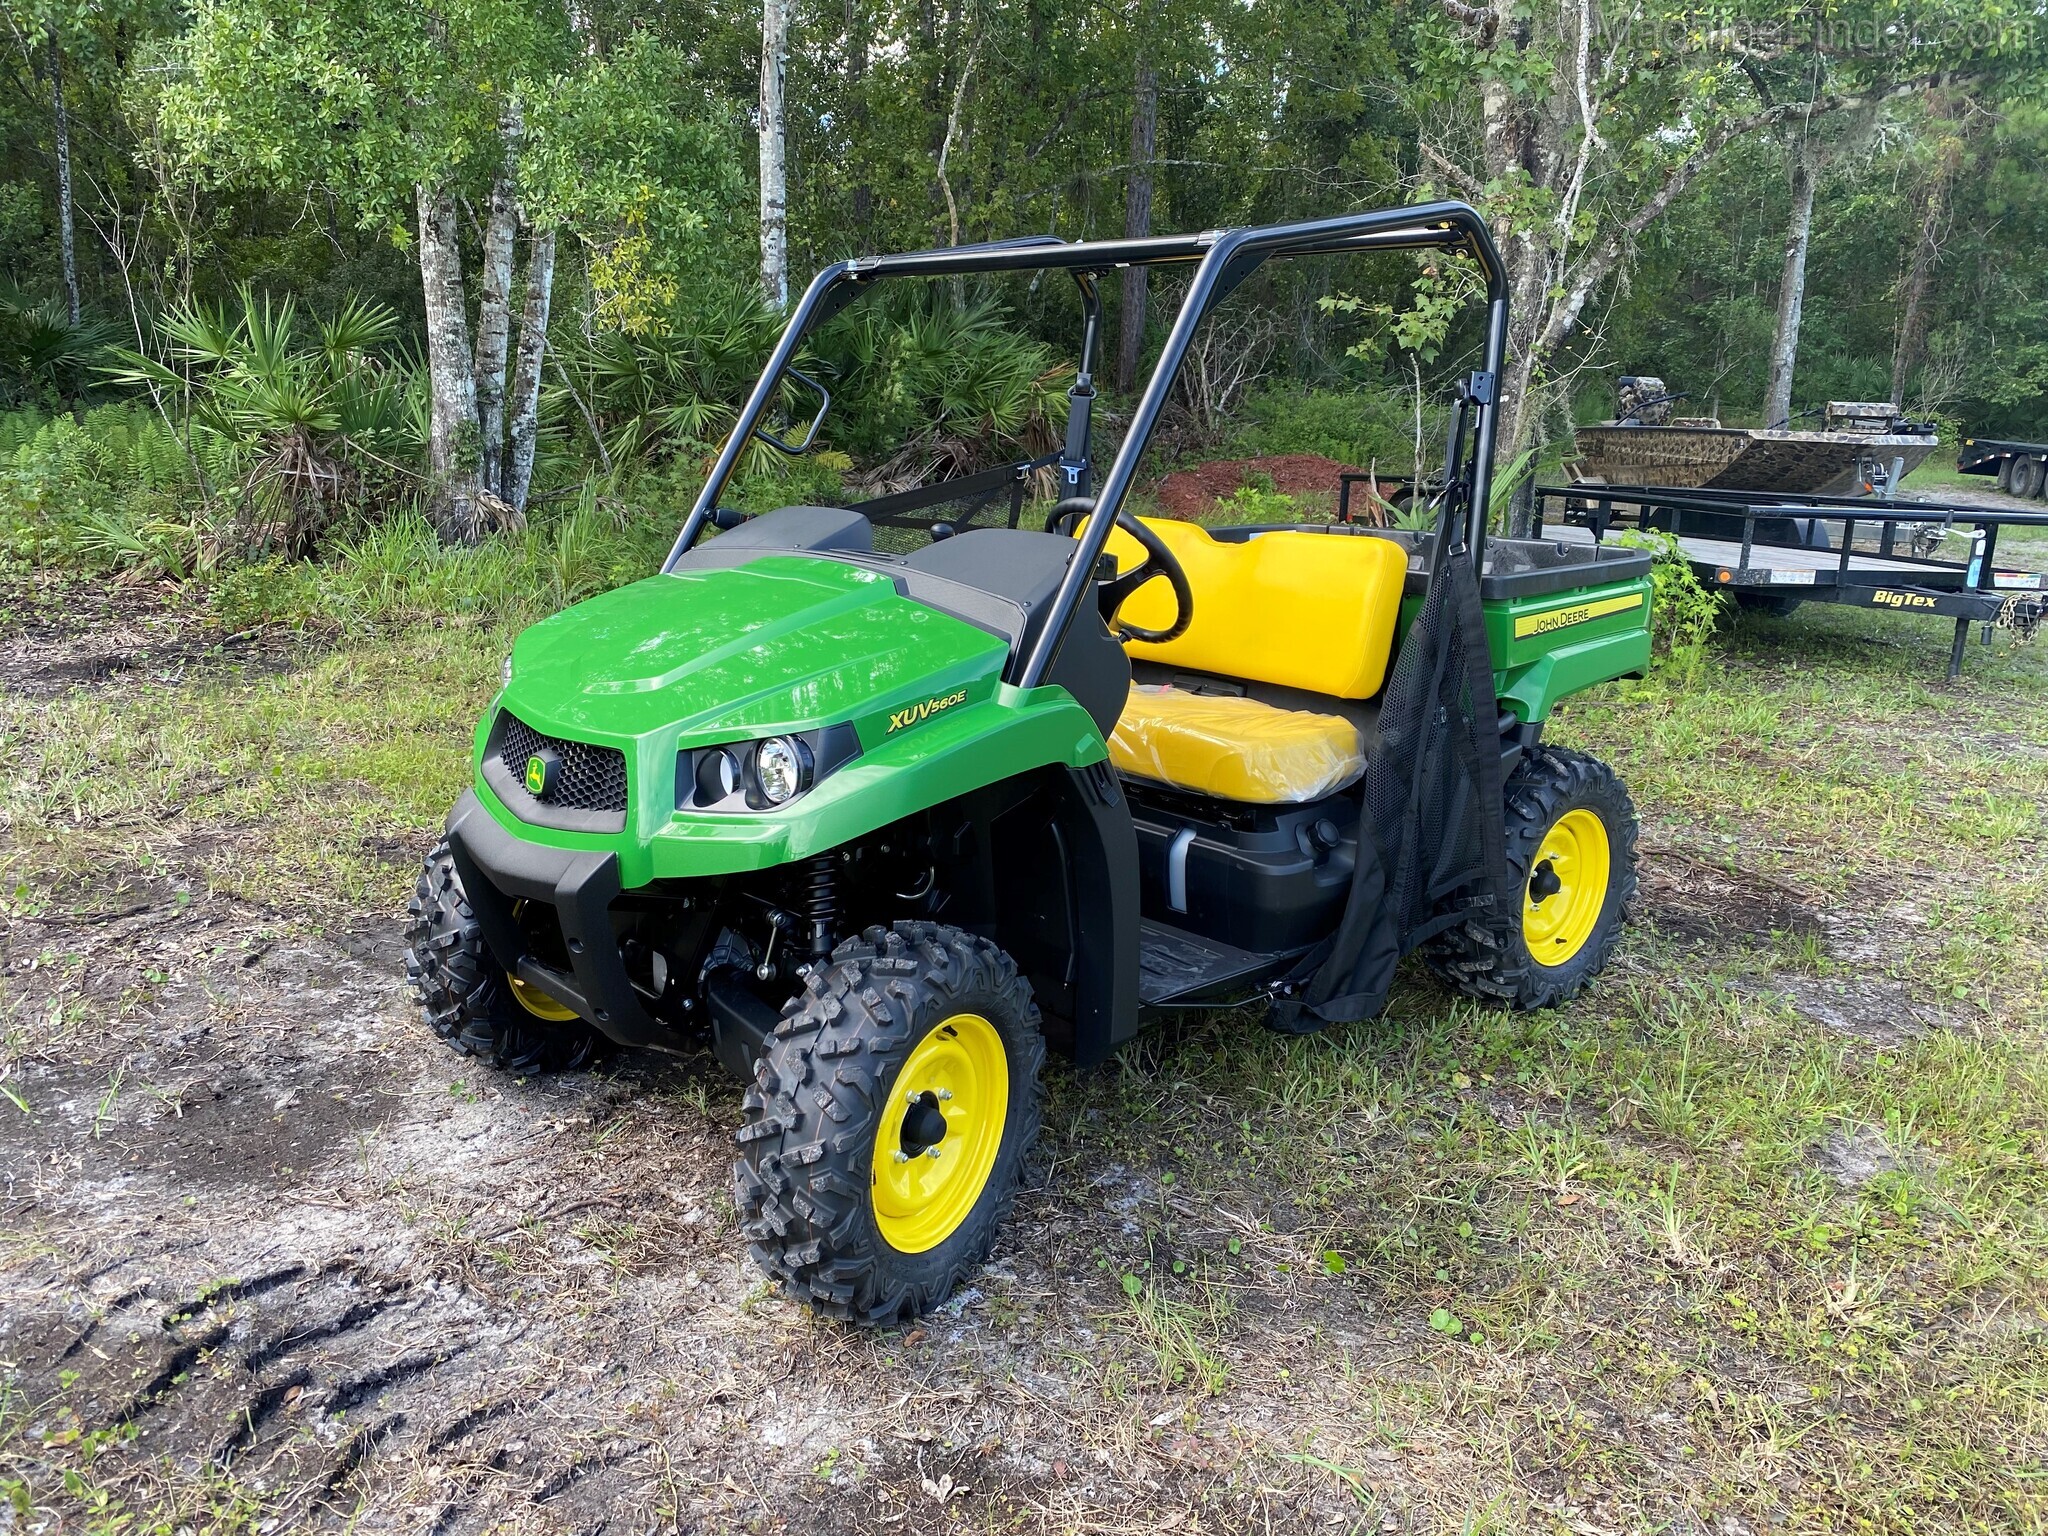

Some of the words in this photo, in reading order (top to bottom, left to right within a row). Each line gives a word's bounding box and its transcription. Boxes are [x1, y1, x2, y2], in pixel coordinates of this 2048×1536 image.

[1533, 616, 1559, 633] JOHN
[1560, 609, 1589, 626] DEERE
[886, 689, 968, 734] XUV560E
